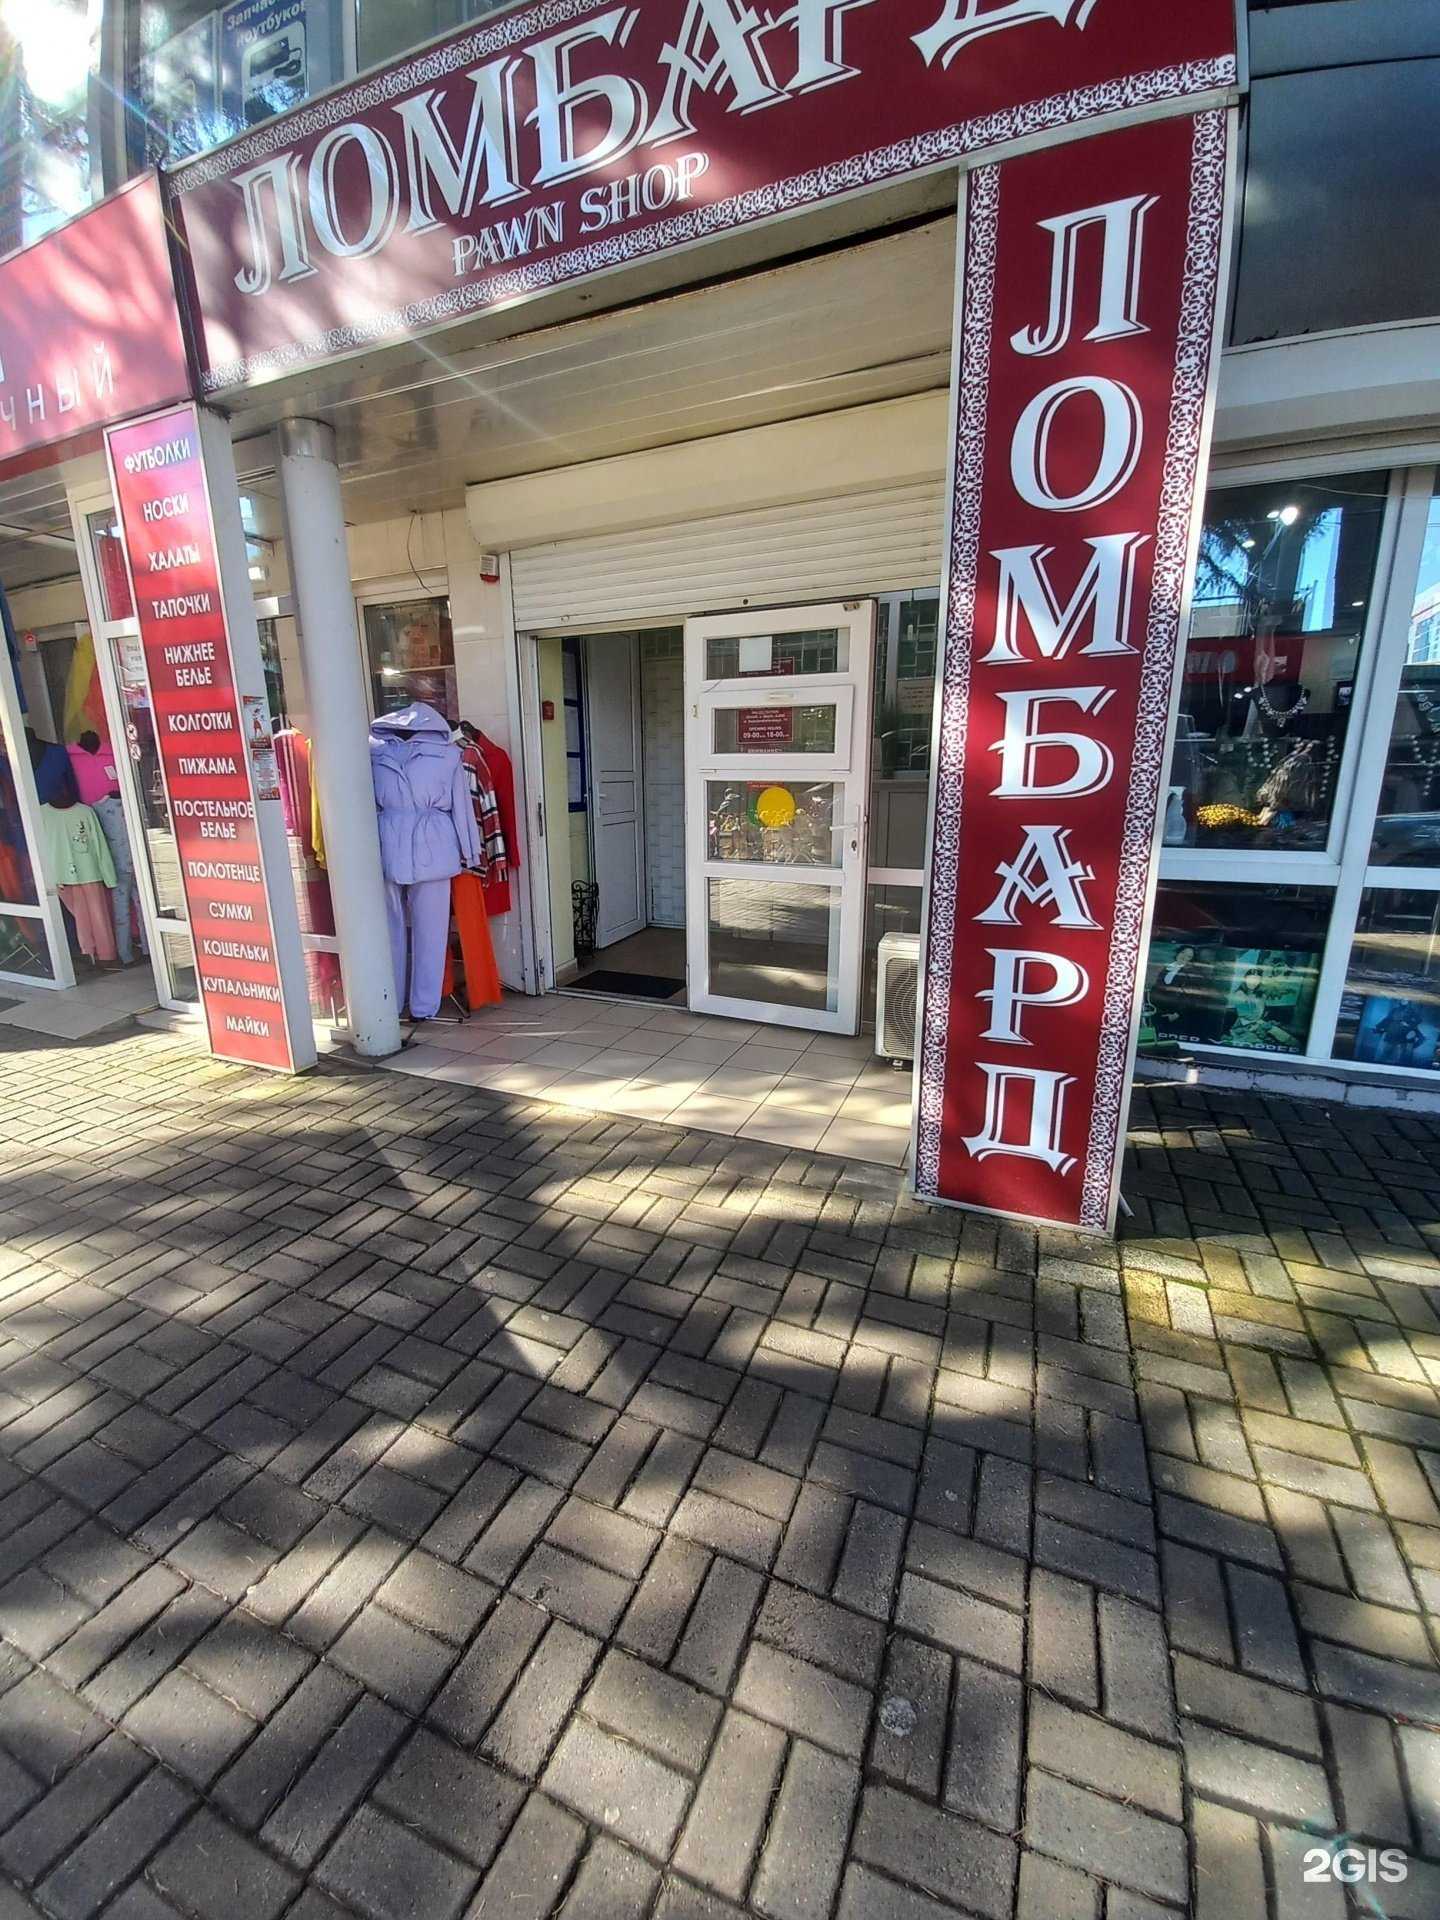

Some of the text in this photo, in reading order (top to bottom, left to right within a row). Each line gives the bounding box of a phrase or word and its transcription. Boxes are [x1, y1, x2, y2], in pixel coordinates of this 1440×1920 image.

[453, 152, 710, 276] PAWN SHOP
[124, 438, 191, 474] ФУТБОЛКИ
[143, 495, 190, 522] НОСКИ
[148, 544, 201, 572] ХАЛАТЫ
[152, 594, 211, 620] ТАПОЧКИ
[164, 642, 216, 664] НИЖНЕЕ
[175, 667, 213, 687] БЕЛЬЕ
[959, 194, 1161, 1177] ЛОМБАРД
[168, 710, 233, 732] КОЛГОТКИ
[178, 757, 237, 775] ПИЖАМА
[174, 799, 254, 819] ПОСТЕЛЬНОЕ
[200, 821, 237, 839] БЕЛЬЕ
[188, 860, 261, 883] ПОЛОТЕНЦЕ
[208, 901, 253, 921] СУМКИ
[203, 939, 270, 963] КОШЕЛЬКИ
[203, 976, 281, 1002] КУПАЛЬНИКИ
[226, 1014, 270, 1037] МАЙКИ
